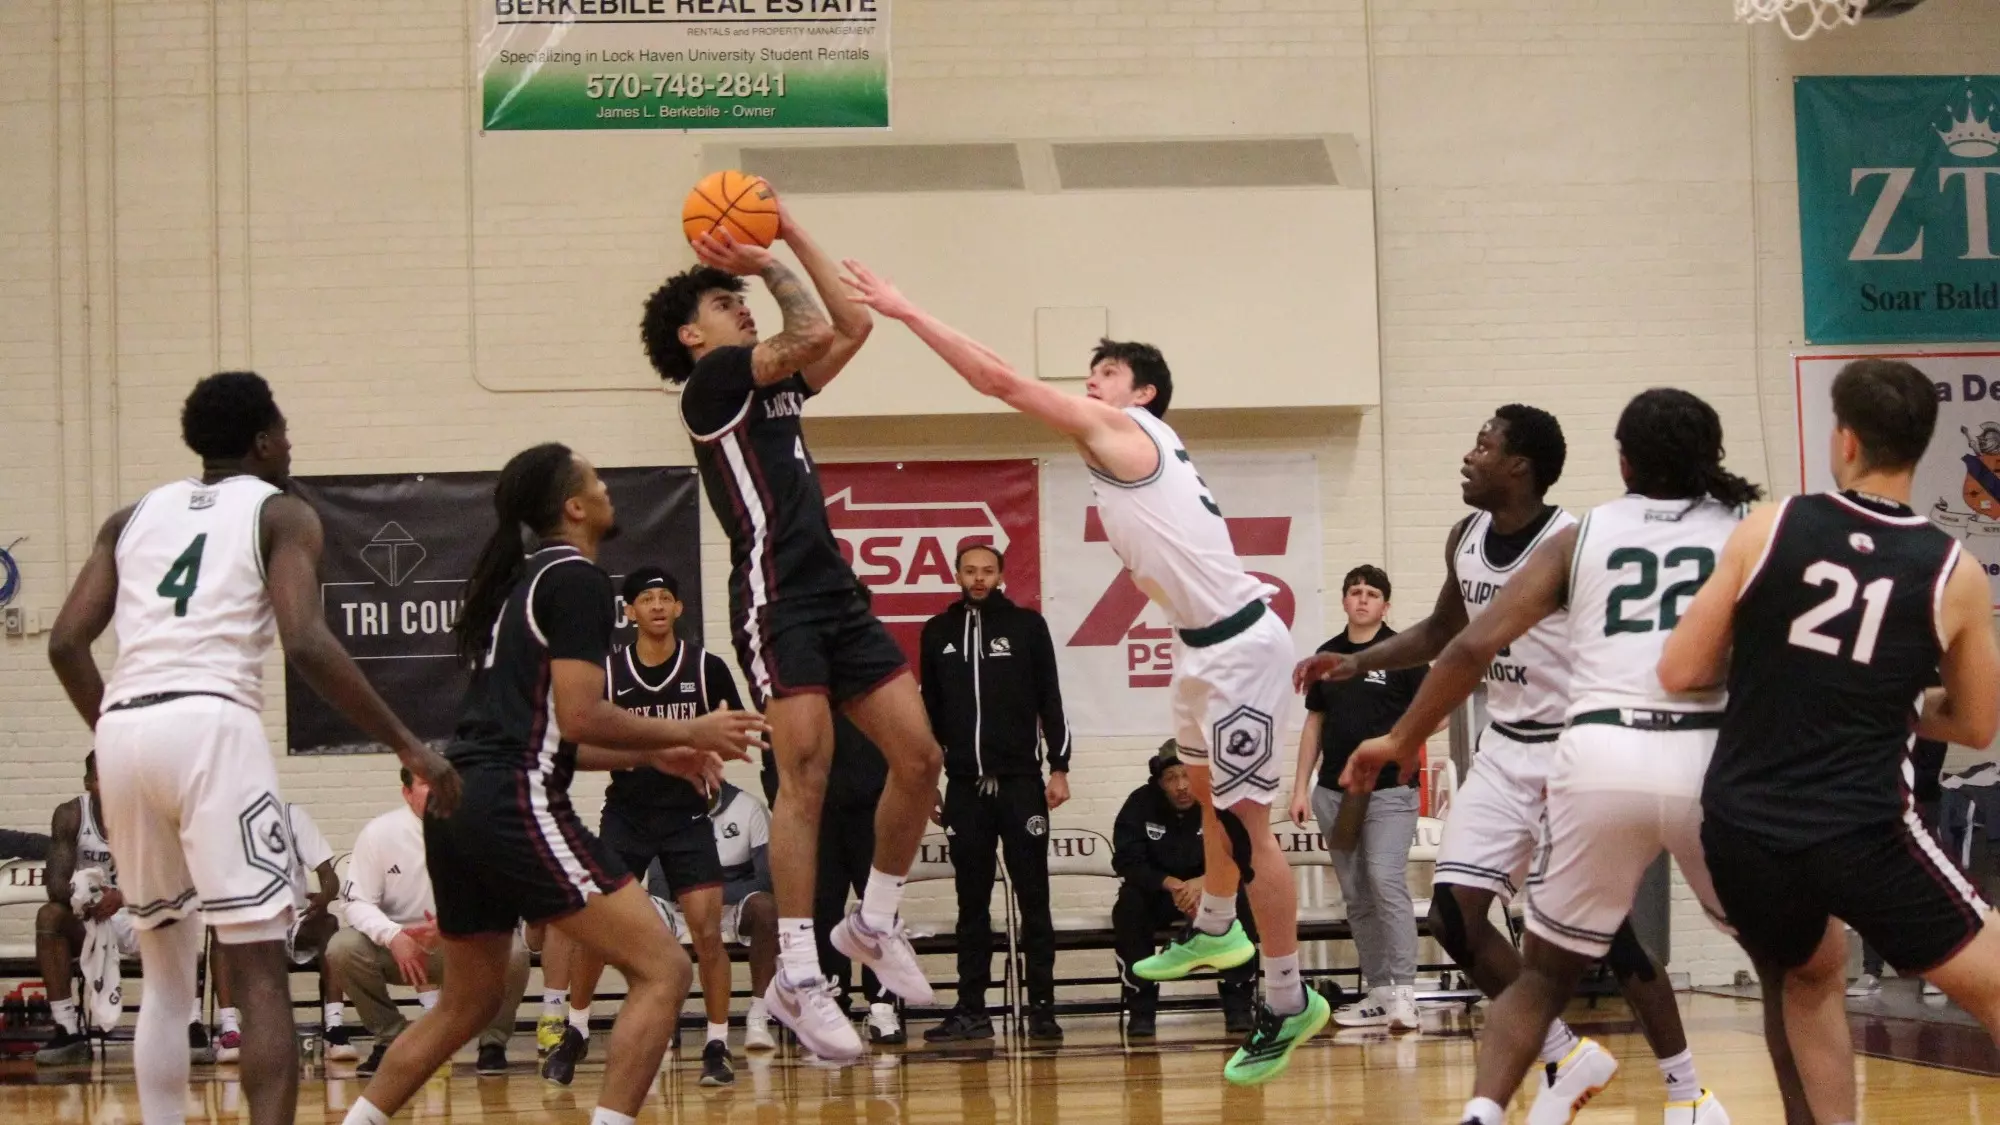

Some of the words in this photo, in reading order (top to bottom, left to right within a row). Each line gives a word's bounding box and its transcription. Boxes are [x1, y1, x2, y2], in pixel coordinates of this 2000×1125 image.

[676, 0, 756, 14] REAL
[687, 28, 731, 37] RENTALS
[733, 28, 749, 36] and
[752, 27, 804, 36] PROPERTY
[807, 26, 876, 35] MANAGEMENT
[500, 50, 581, 65] Specializing
[586, 50, 597, 62] in
[602, 50, 635, 62] Lock
[639, 49, 684, 62] Haven
[688, 49, 755, 64] University
[760, 48, 813, 61] Student
[818, 48, 870, 61] Rentals
[586, 72, 787, 99] 570-748-2841
[596, 106, 640, 118] James
[643, 106, 656, 118] L.
[659, 105, 720, 117] Berkebile
[732, 105, 776, 117] Owner
[1861, 283, 1927, 311] Soar
[1935, 281, 1999, 311] Bald
[156, 533, 207, 617] 4
[1603, 546, 1716, 637] 22
[341, 602, 389, 636] TRI
[401, 600, 465, 635] COU
[1788, 560, 1894, 664] 21
[1127, 642, 1174, 671] PS
[1486, 662, 1528, 686] OCK
[656, 702, 697, 720] HAVEN
[83, 850, 111, 863] SLIP
[1048, 837, 1098, 857] HU
[9, 867, 48, 887] LH
